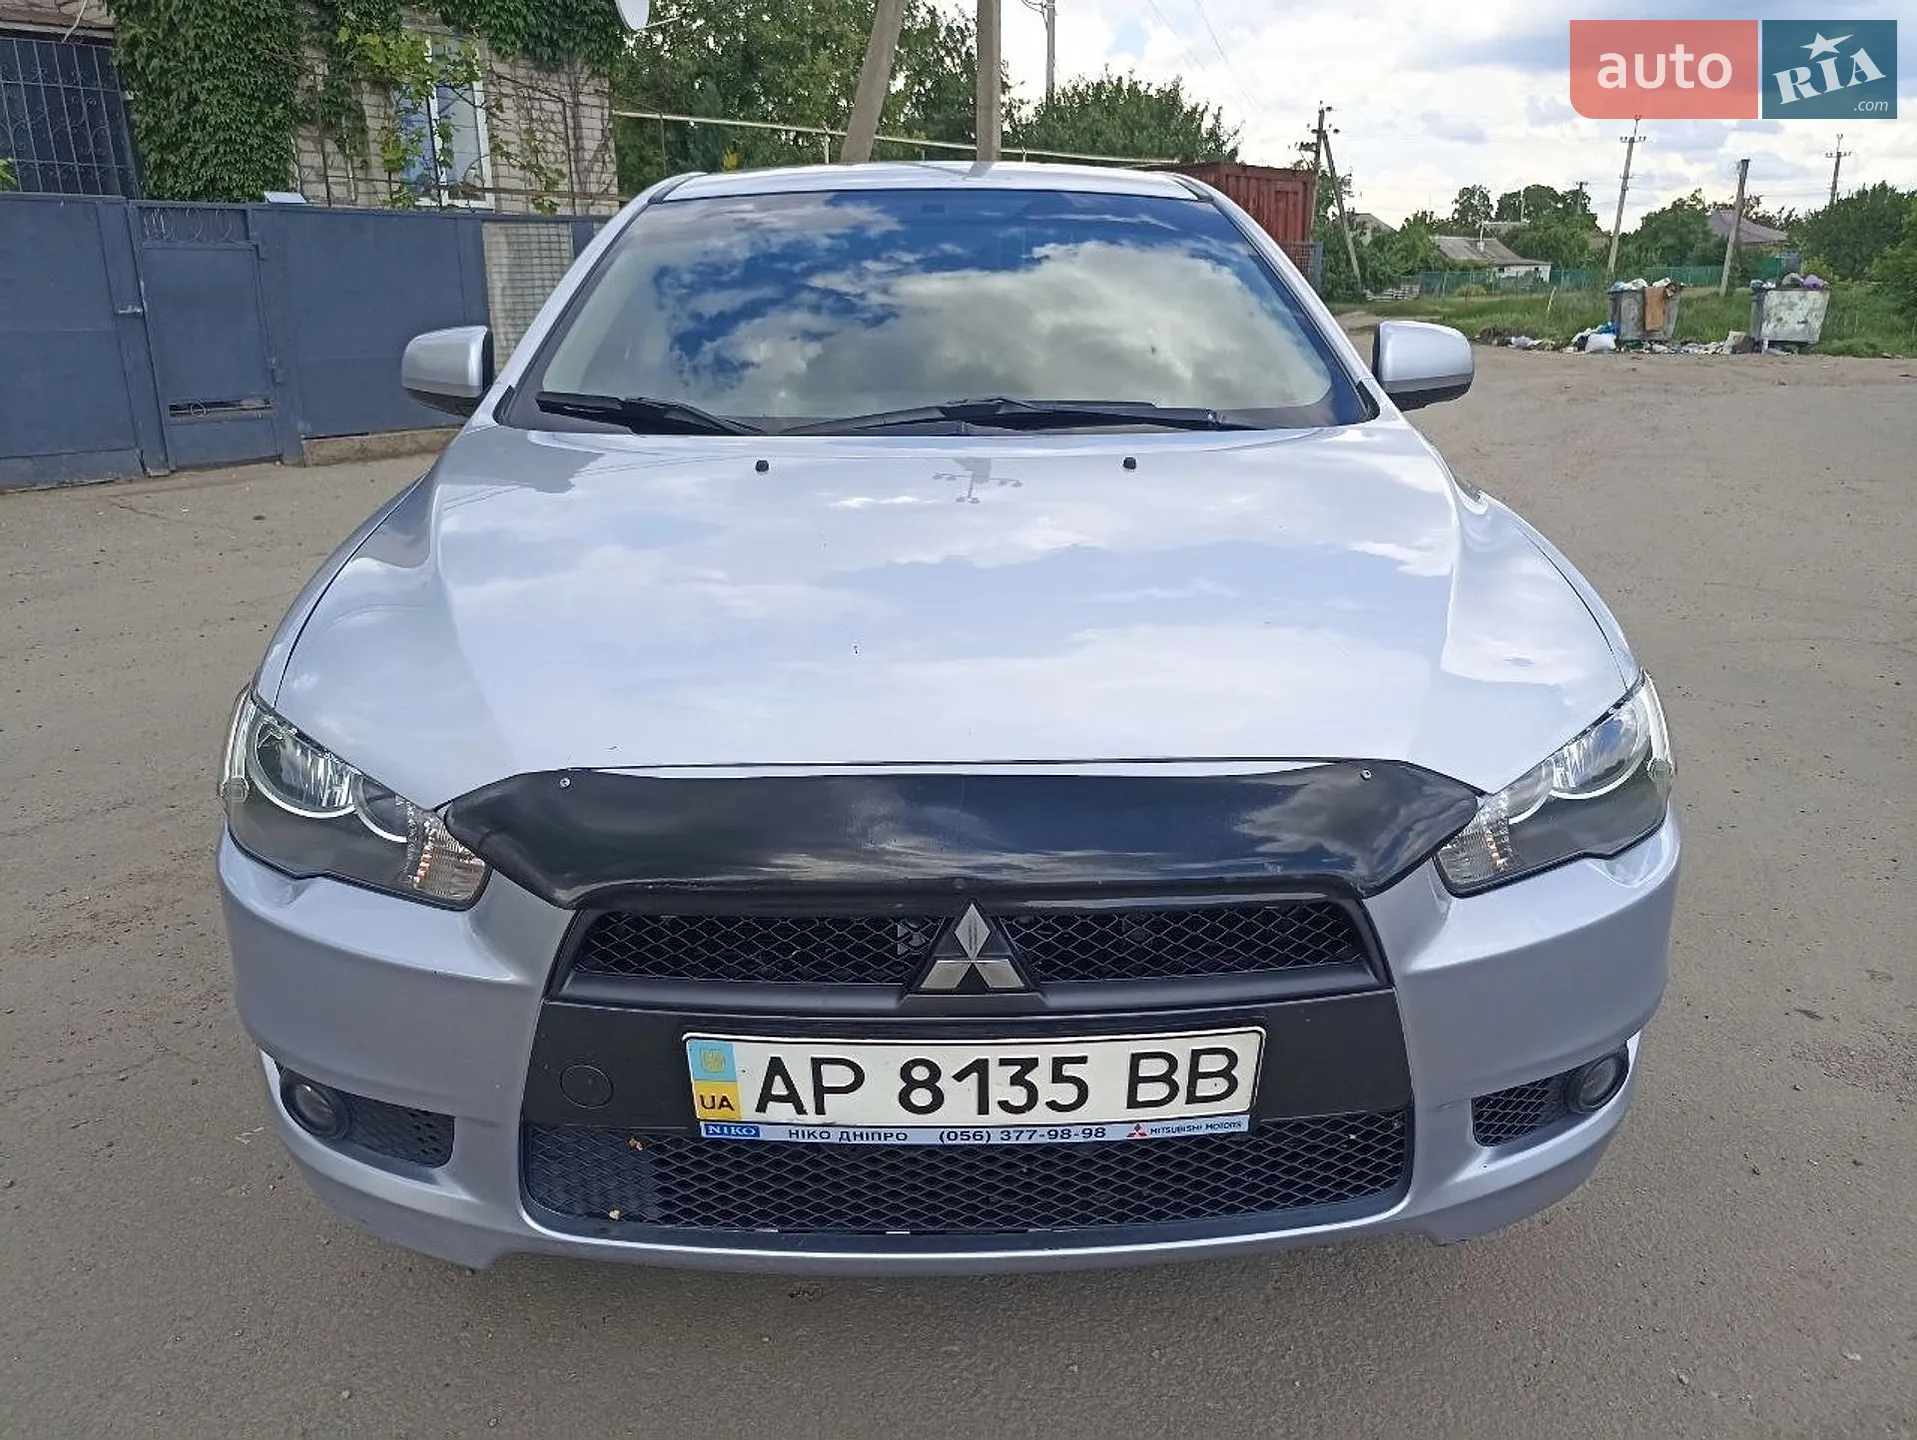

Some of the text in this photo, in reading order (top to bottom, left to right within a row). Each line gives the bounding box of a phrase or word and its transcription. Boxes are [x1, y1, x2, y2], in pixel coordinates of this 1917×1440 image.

[754, 1046, 1240, 1116] AP 8135 BB
[699, 1094, 735, 1111] UA
[707, 1125, 757, 1136] NIKO
[788, 1129, 908, 1142] НІКО ДНІПРО
[938, 1127, 1107, 1143] (056) 377-98-98
[1150, 1125, 1203, 1135] MITSUBISHI
